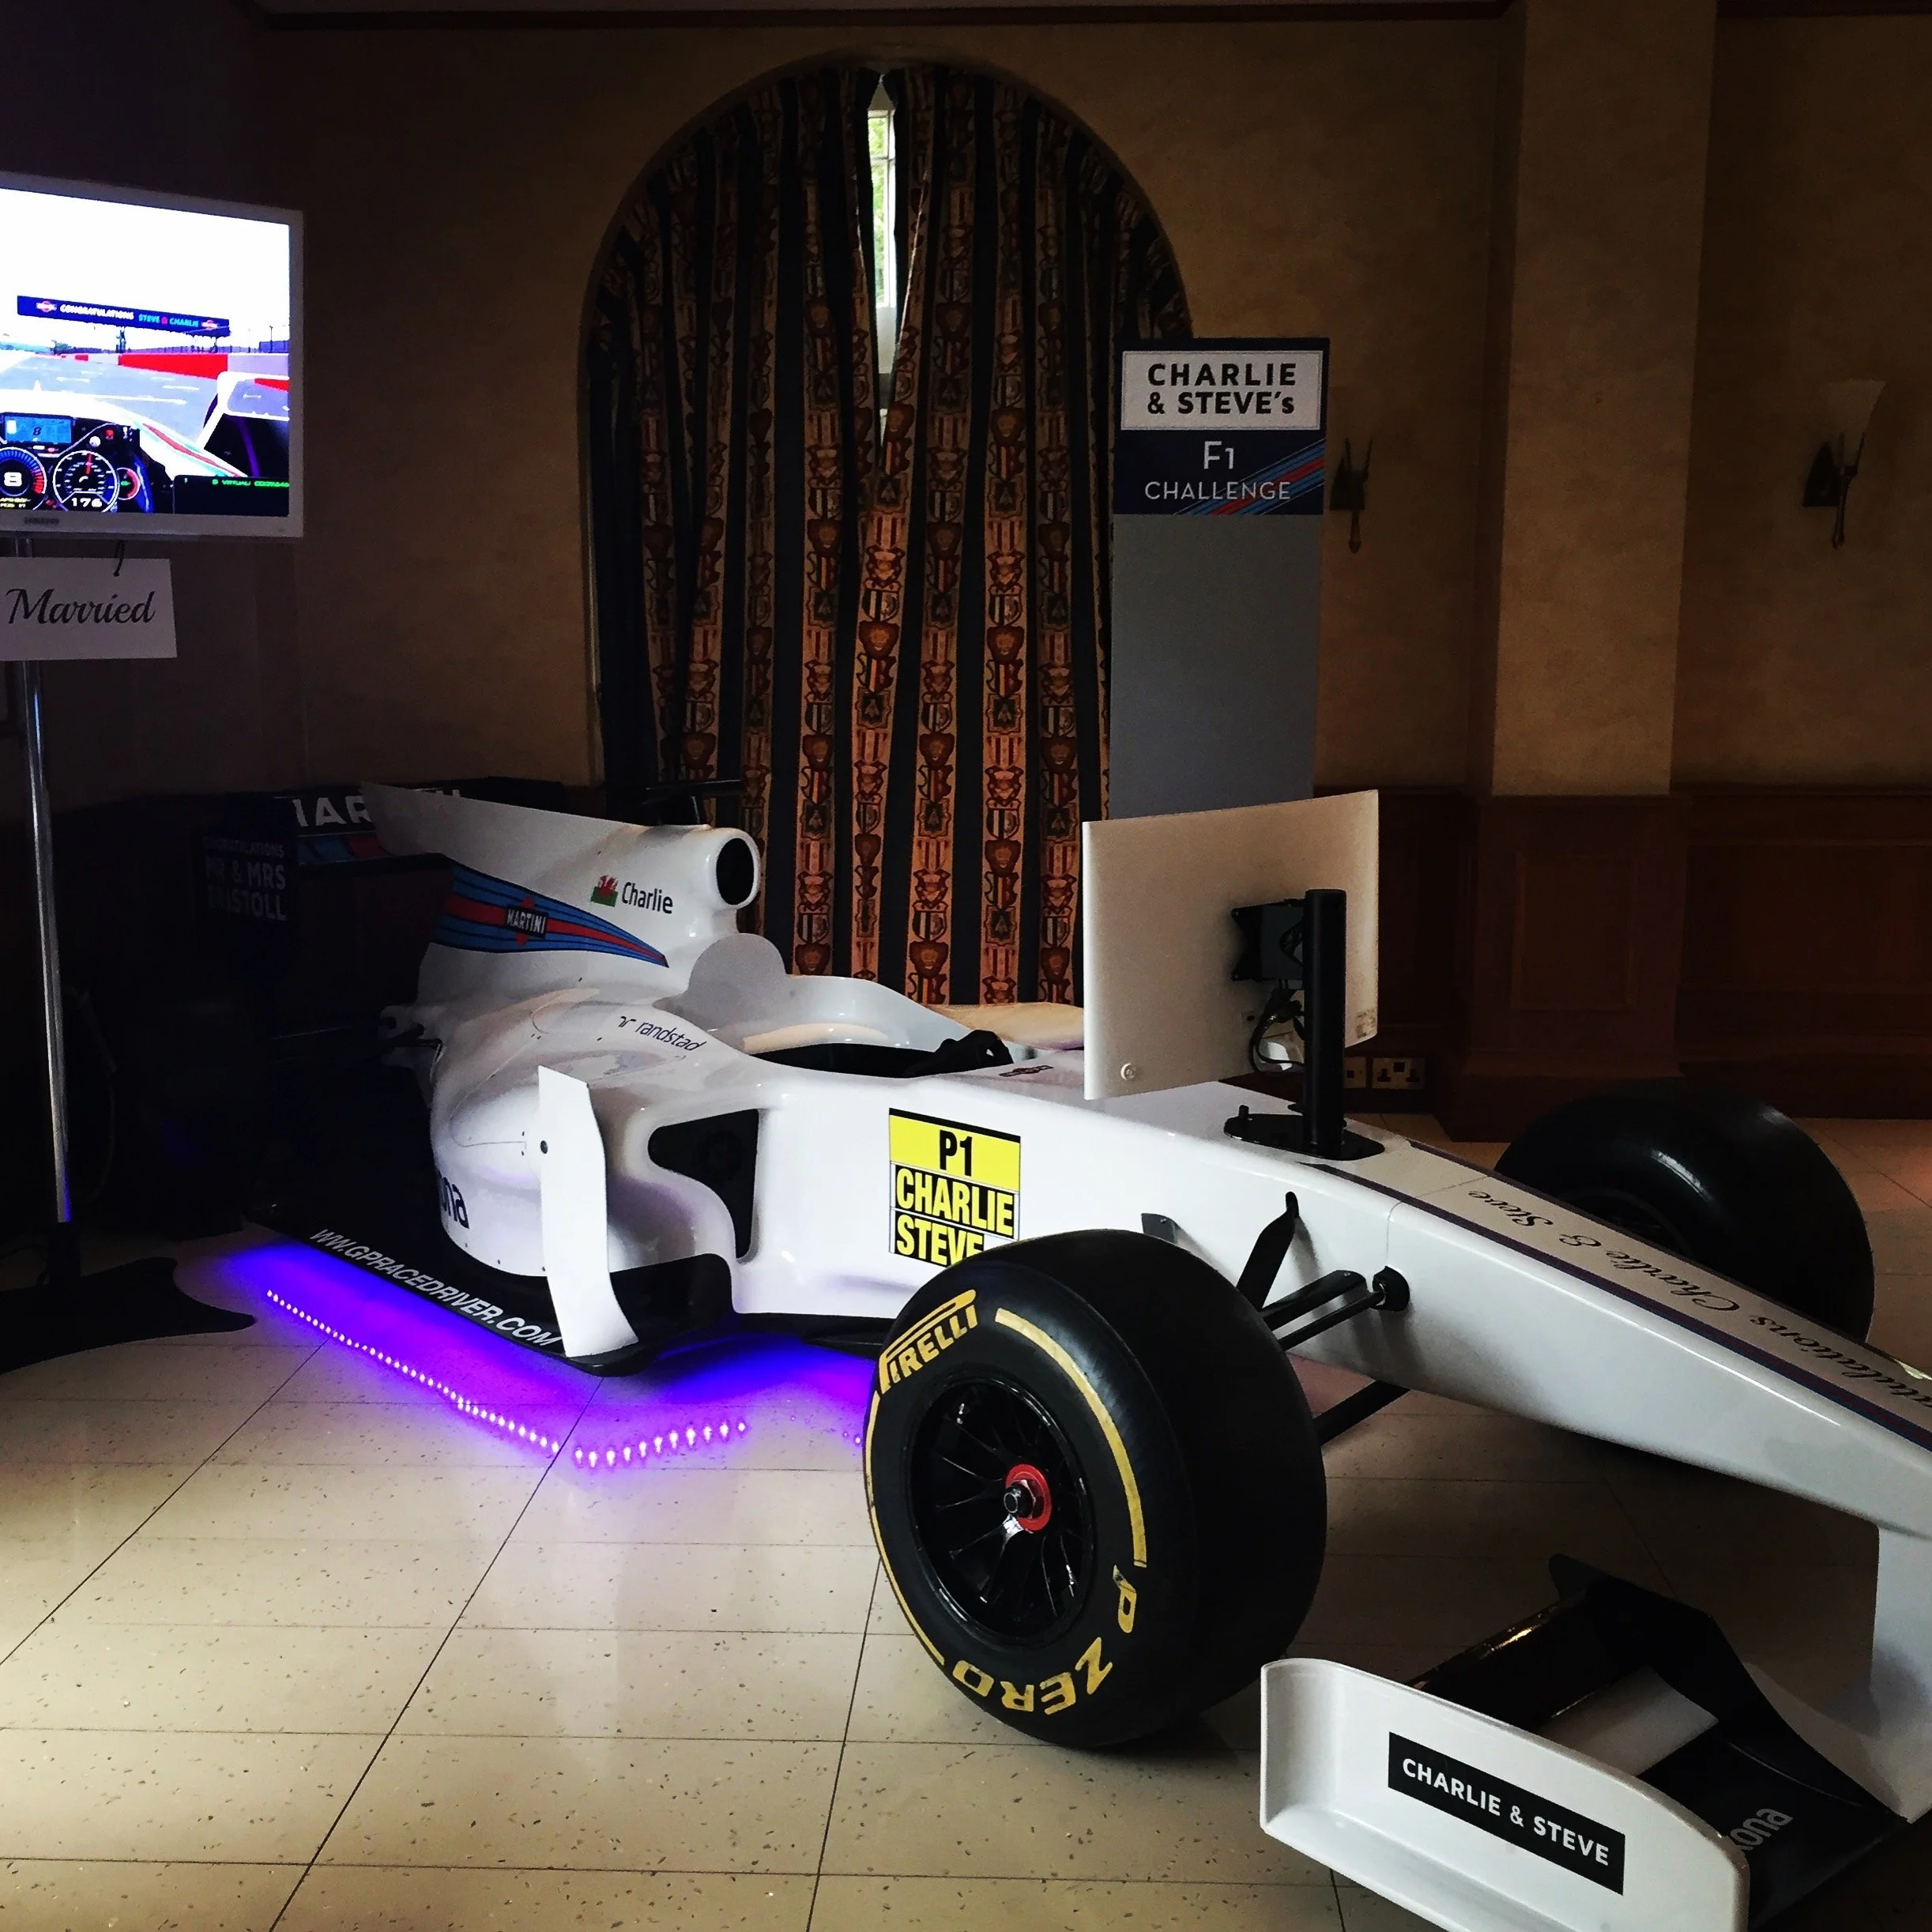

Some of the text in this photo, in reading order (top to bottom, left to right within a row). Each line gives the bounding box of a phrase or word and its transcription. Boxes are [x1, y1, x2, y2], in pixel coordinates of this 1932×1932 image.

[1147, 363, 1296, 386] CHARLIE
[1147, 392, 1294, 415] & STEVE's
[1203, 441, 1234, 469] F1
[72, 498, 102, 507] 176
[1145, 481, 1291, 500] CHALLENGE
[6, 588, 155, 624] Married
[247, 861, 285, 890] MRS
[621, 882, 673, 914] Charlie
[507, 909, 546, 933] MARTINI
[635, 1022, 707, 1052] randstad
[940, 1130, 973, 1177] P1
[896, 1168, 1014, 1237] CHARLIE
[1468, 1190, 1554, 1226] Steve
[1606, 1249, 1739, 1311] Charlie
[879, 1289, 978, 1395] PIRELLI
[951, 1564, 1137, 1715] P ZERO
[1403, 1757, 1609, 1866] CHARLIE & STEVE
